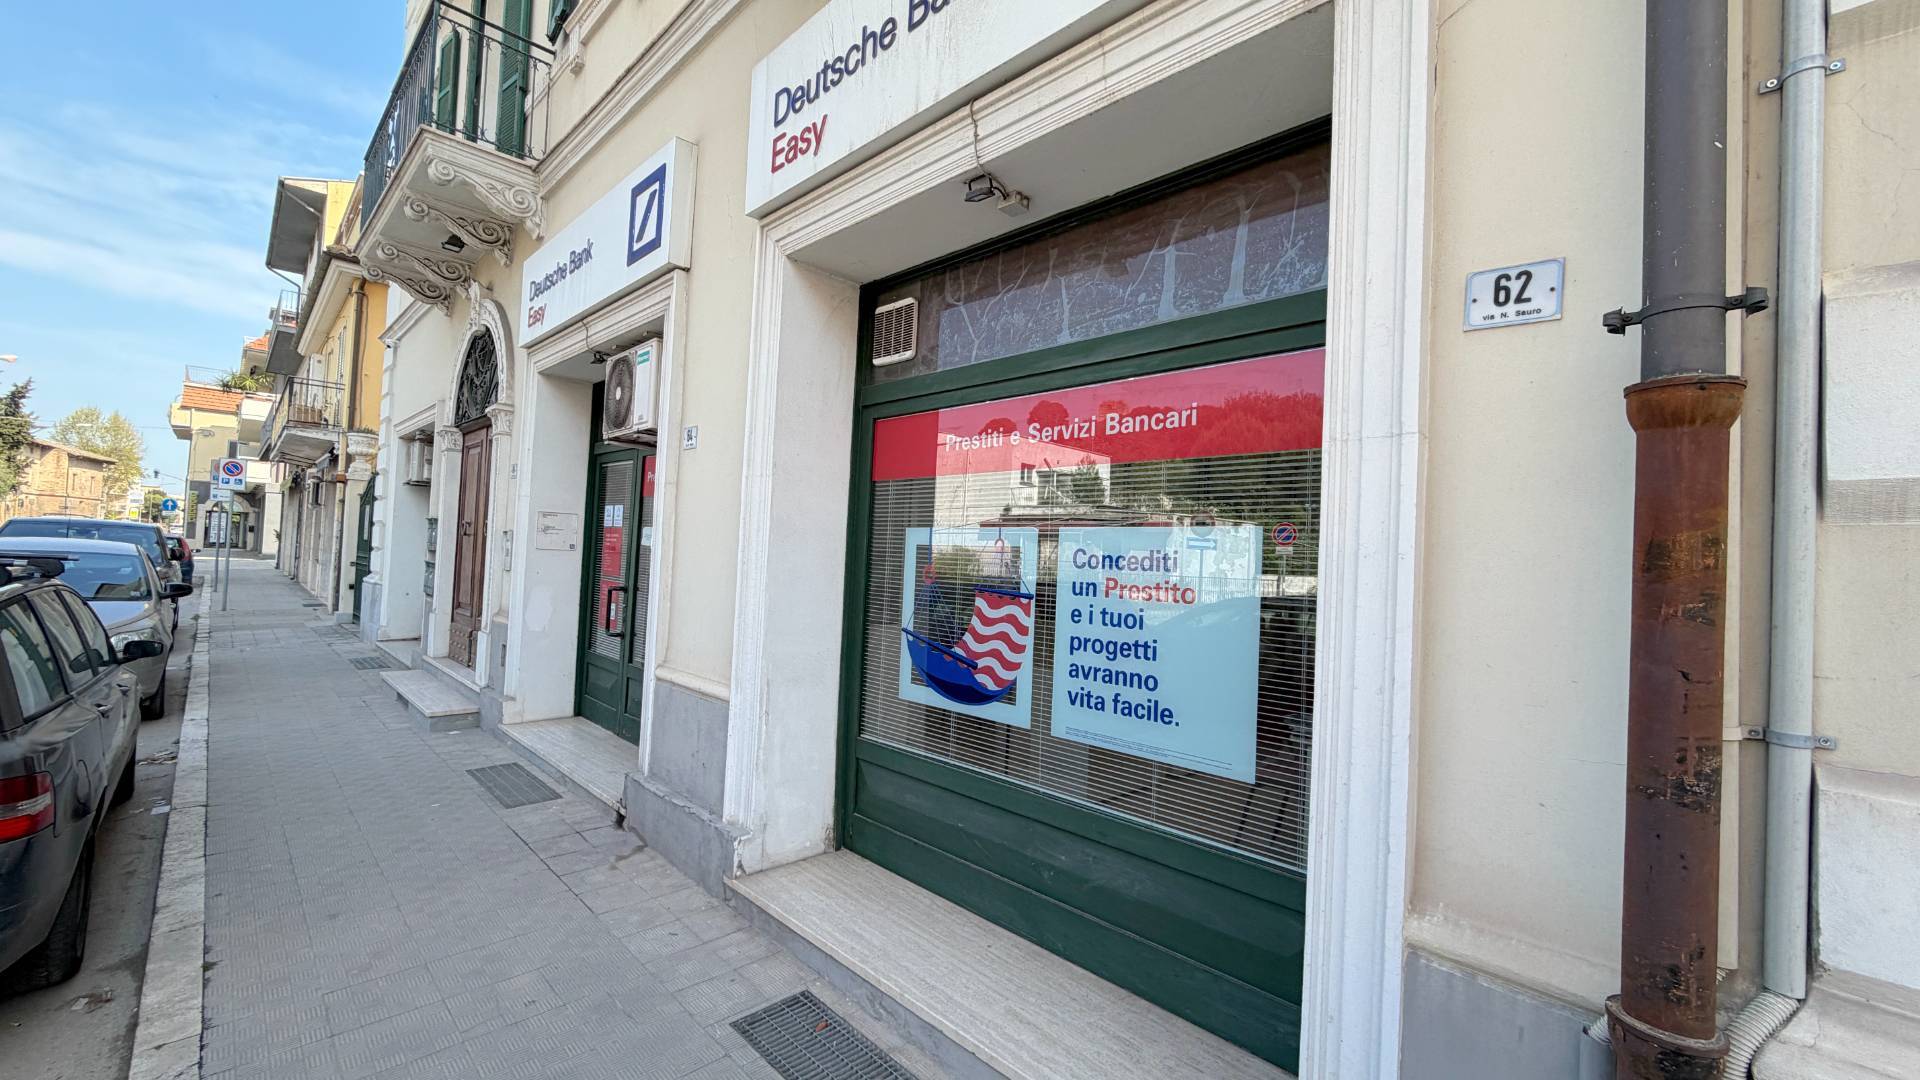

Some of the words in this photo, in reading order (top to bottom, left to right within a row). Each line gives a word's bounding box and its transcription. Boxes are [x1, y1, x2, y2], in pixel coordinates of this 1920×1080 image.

[773, 16, 898, 128] Deutsche
[770, 114, 829, 174] Easy
[528, 261, 568, 302] Deutsche
[568, 238, 594, 275] Bank
[1493, 270, 1533, 307] 62
[527, 302, 547, 328] Easy
[945, 427, 1005, 452] Prestiti
[1009, 430, 1021, 446] e
[1027, 415, 1097, 445] Servizi
[1105, 402, 1199, 437] Bancari
[1072, 548, 1179, 573] Concediti
[1071, 580, 1098, 599] un
[1104, 577, 1197, 605] Prestito
[1070, 607, 1082, 625] e
[1088, 604, 1094, 626] i
[1100, 607, 1145, 631] tuoi
[1069, 635, 1159, 662] progetti
[1068, 662, 1159, 693] avranno
[1067, 686, 1106, 713] vita
[1112, 692, 1180, 727] facile.
